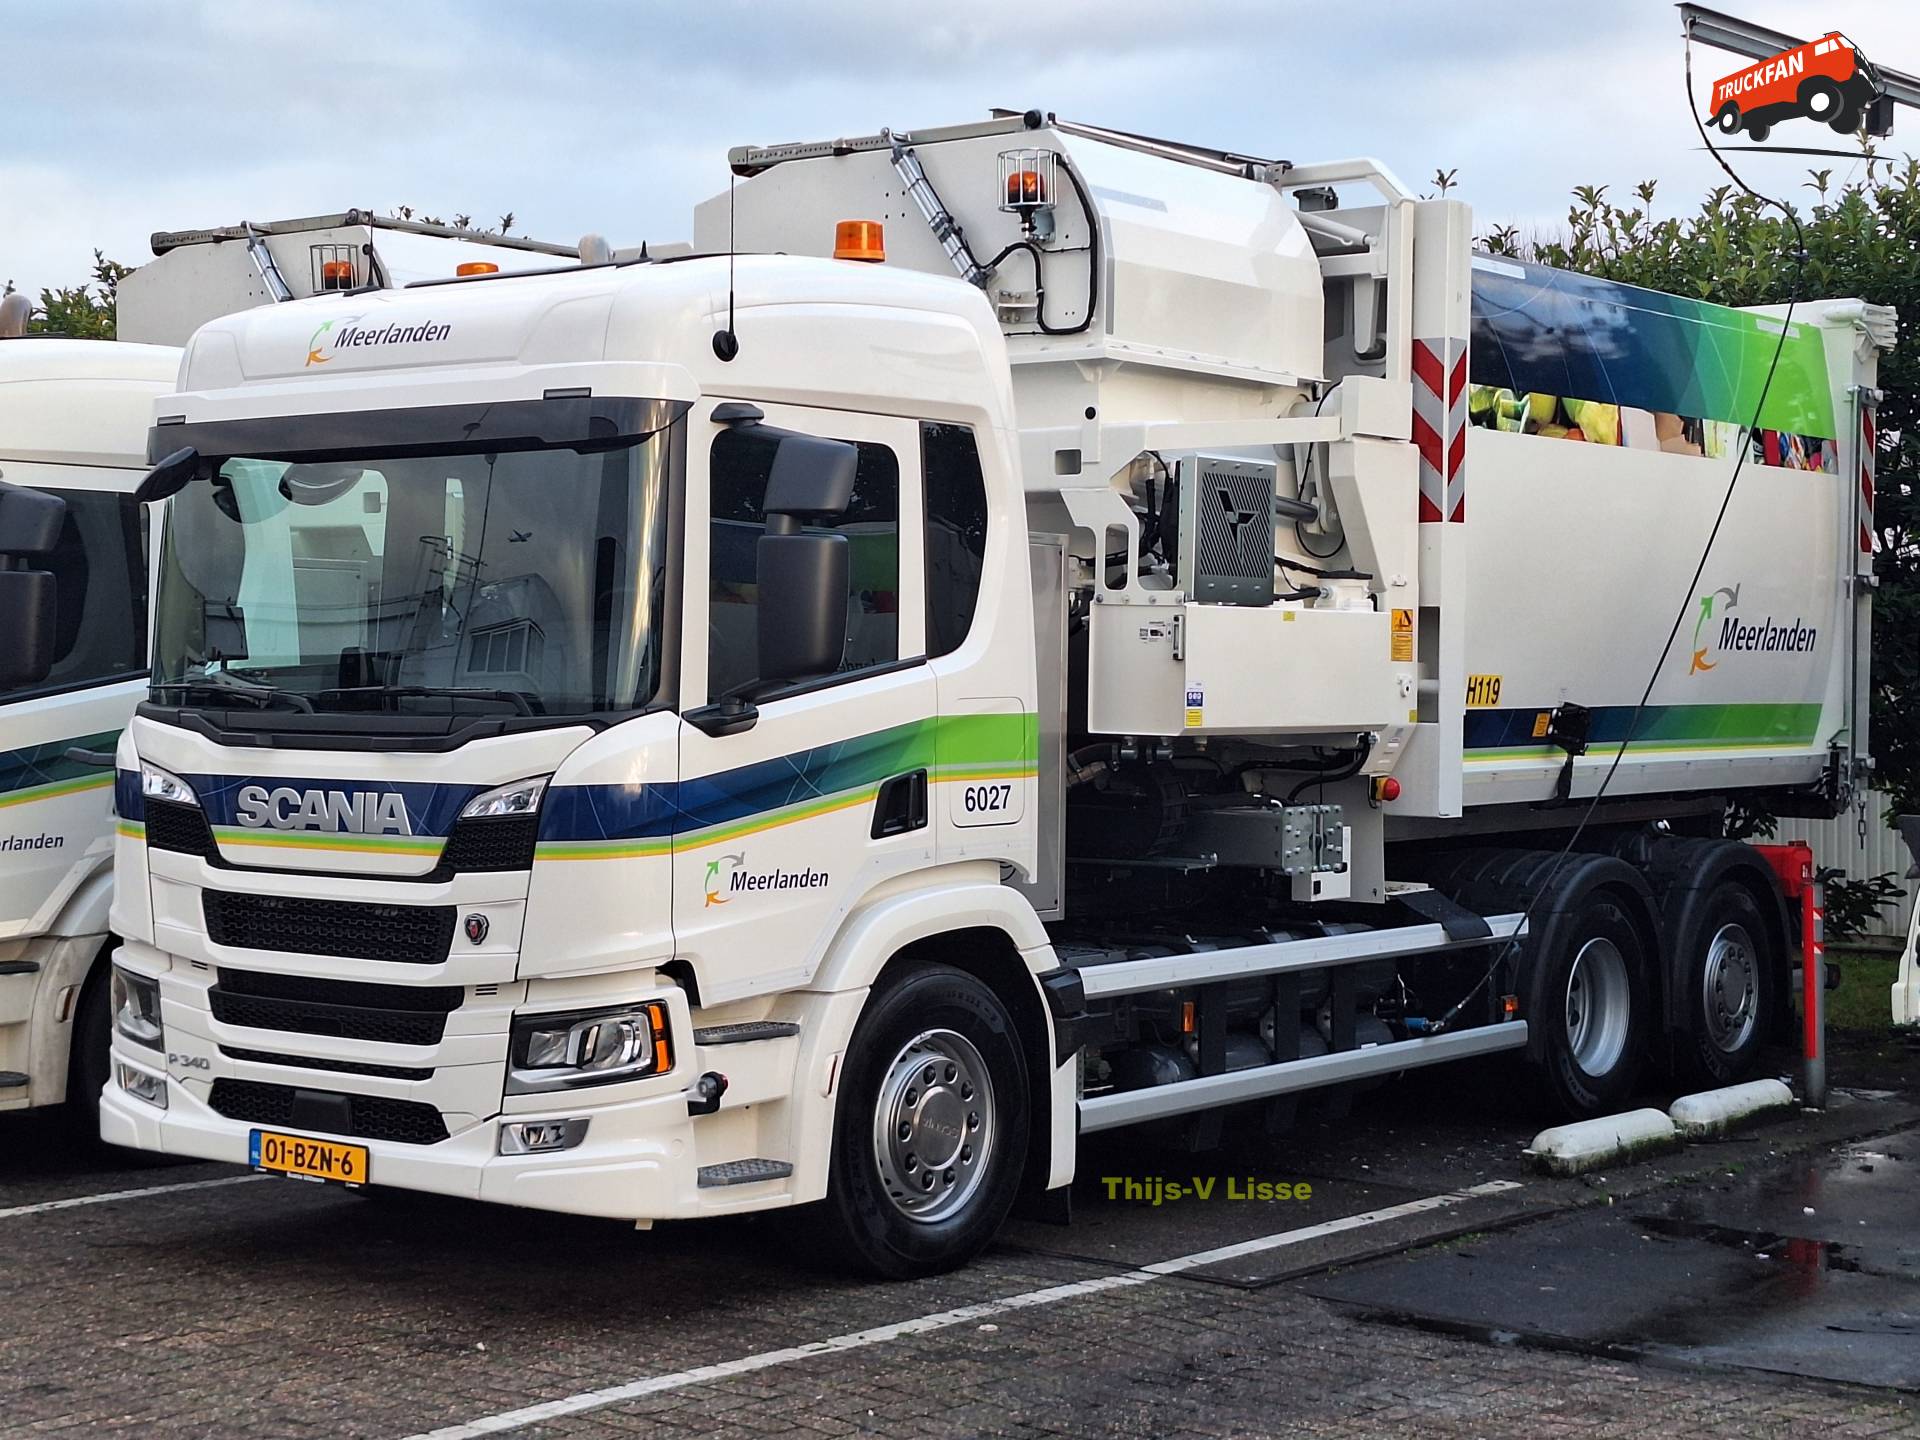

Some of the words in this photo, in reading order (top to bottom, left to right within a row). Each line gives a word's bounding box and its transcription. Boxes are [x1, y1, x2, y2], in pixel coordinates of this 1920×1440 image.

[333, 319, 451, 349] Meerlanden
[1718, 616, 1817, 653] Meerlanden
[1466, 677, 1501, 705] H119
[236, 785, 413, 836] SCANIA
[964, 784, 1011, 812] 6027
[0, 833, 64, 851] rlanden
[729, 867, 829, 891] Meerlanden
[180, 1055, 210, 1070] 340
[265, 1138, 353, 1175] 01-BZN-6
